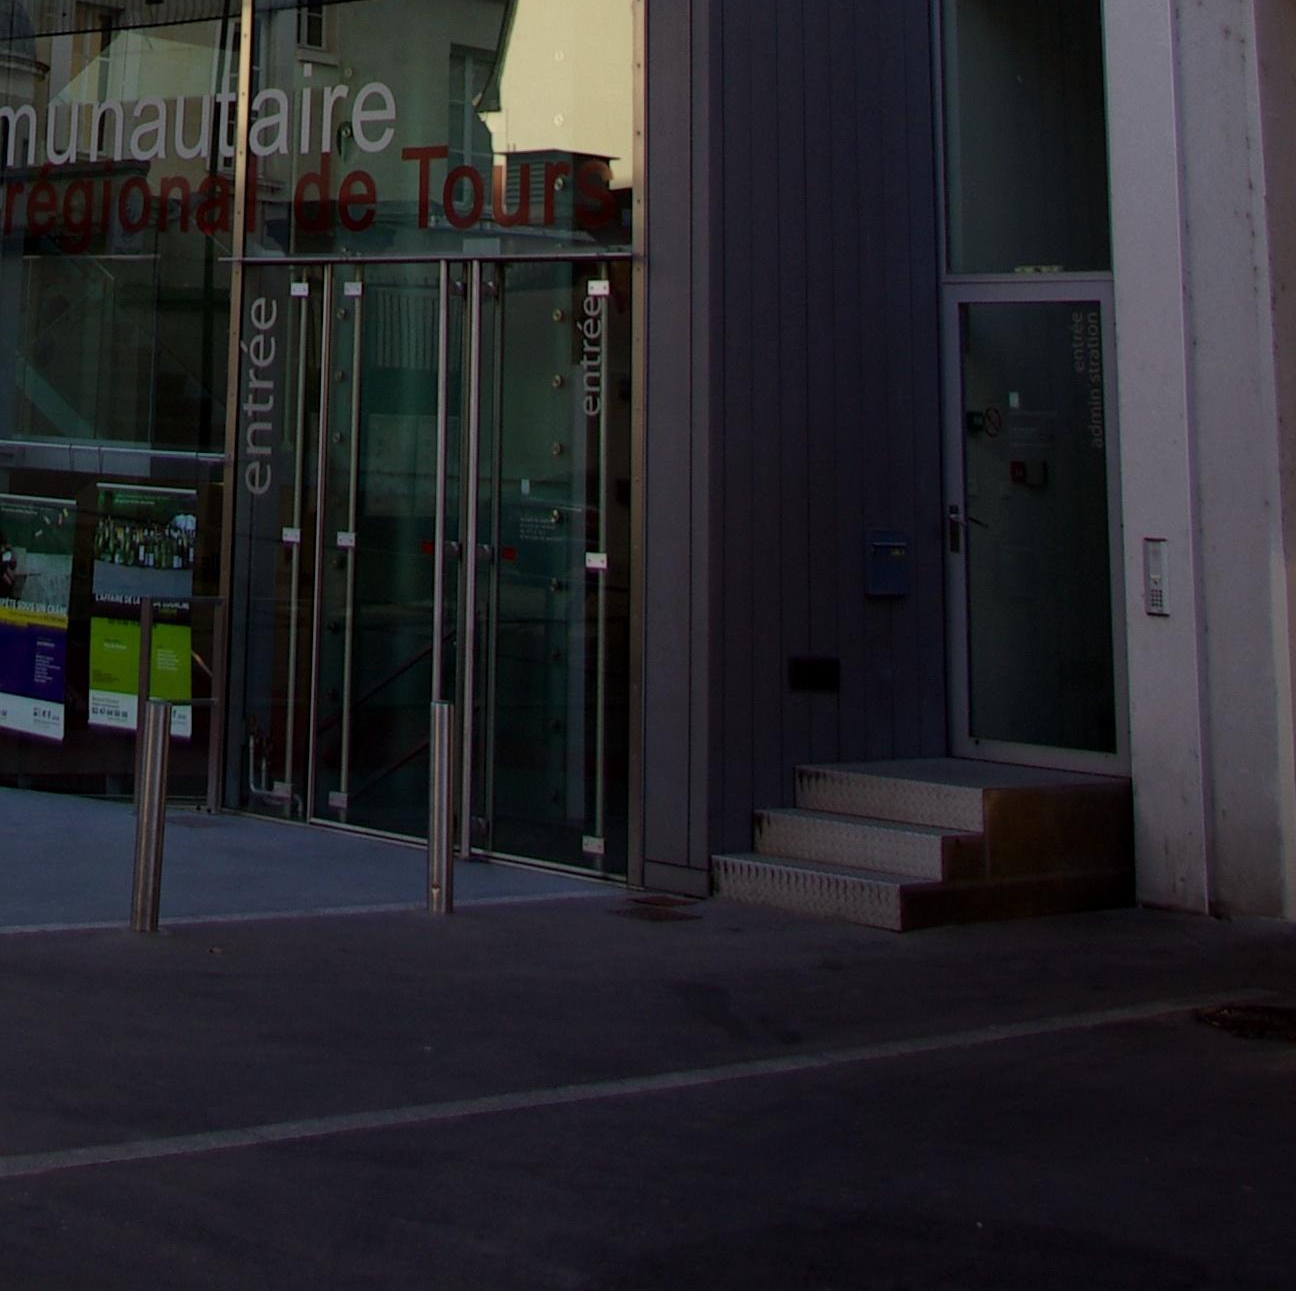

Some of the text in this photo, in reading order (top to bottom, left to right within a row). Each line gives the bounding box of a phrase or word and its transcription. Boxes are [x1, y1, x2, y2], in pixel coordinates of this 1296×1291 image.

[5, 155, 257, 254] régional
[294, 152, 377, 233] de
[402, 146, 616, 229] Tours
[240, 296, 278, 495] entrée
[576, 295, 601, 417] entrée
[1071, 311, 1085, 372] entrée
